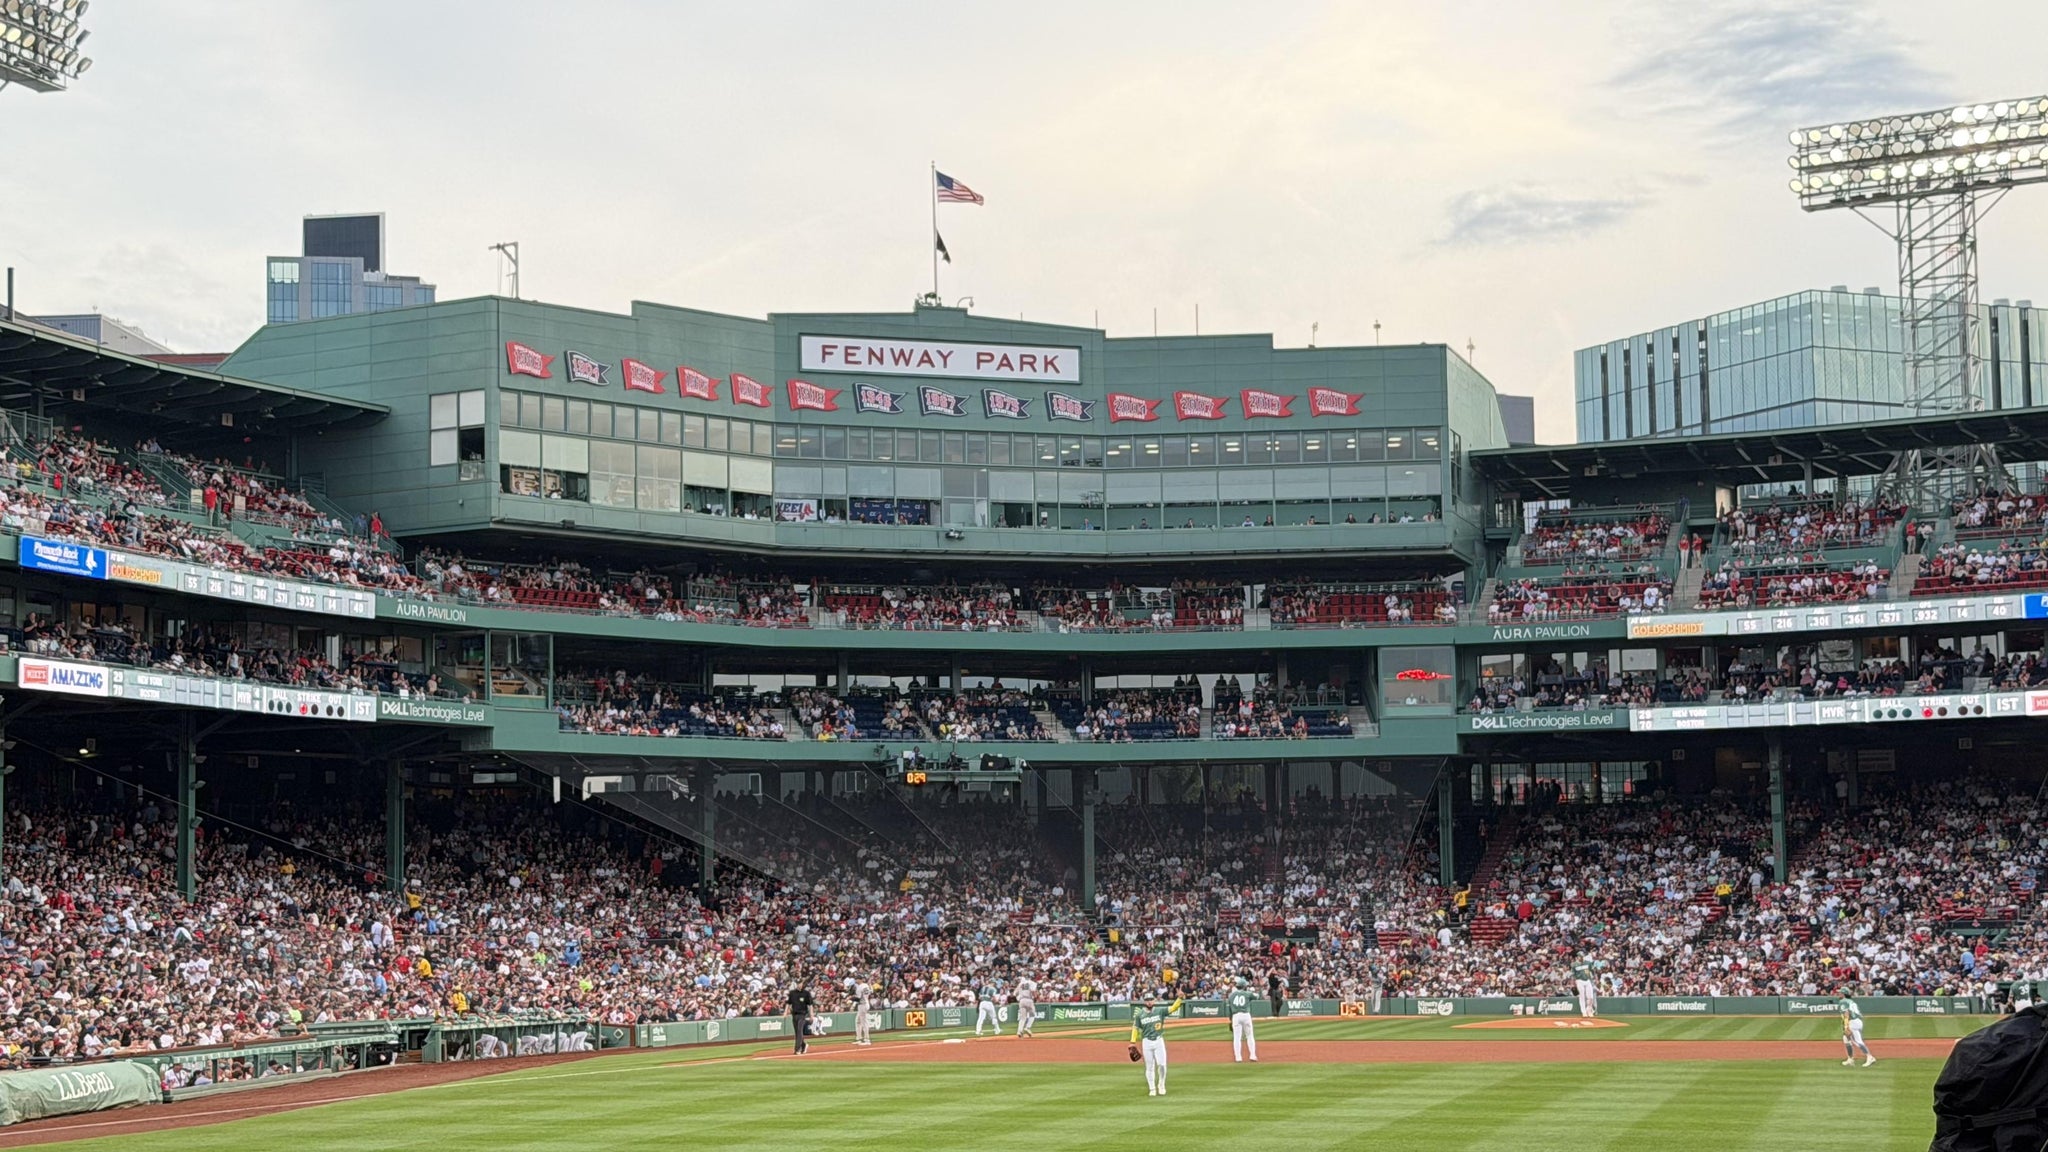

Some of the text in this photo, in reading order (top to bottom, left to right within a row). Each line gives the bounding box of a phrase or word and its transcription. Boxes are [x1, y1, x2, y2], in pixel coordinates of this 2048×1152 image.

[821, 345, 1061, 374] FENWAY PARK
[572, 358, 600, 380] 1904
[989, 395, 1019, 413] 1975
[1113, 399, 1147, 416] 2004
[1180, 398, 1214, 415] 2007
[111, 564, 162, 583] GOLDSCHMIDT
[187, 577, 197, 589] 55
[353, 601, 364, 613] 40
[1957, 607, 1968, 618] 14
[1992, 605, 2006, 616] 40
[427, 606, 466, 622] PAVILION
[1845, 614, 1865, 625] .361
[1880, 612, 1900, 623] .571
[1914, 609, 1938, 621] .932
[1743, 620, 1757, 631] 55
[1776, 618, 1793, 629] 216
[1809, 616, 1829, 627] .301
[1535, 625, 1590, 637] PAVILION
[1632, 622, 1704, 636] GOLDSCHMIDT
[51, 667, 103, 689] AMAZING
[272, 689, 288, 700] BALL
[297, 692, 321, 704] STRIKE
[328, 695, 343, 705] OUT
[1880, 699, 1904, 708] BALL
[1918, 696, 1950, 706] STRIKE
[1960, 696, 1979, 705] OUT
[382, 700, 485, 722] DELL Technologies Level
[1472, 713, 1613, 729] DELL Technologies Level
[1639, 721, 1651, 730] 70
[1676, 720, 1705, 728] BOSTON
[2018, 985, 2030, 996] 39
[1233, 995, 1246, 1007] 40
[1417, 1000, 1438, 1008] Ninety
[1657, 1001, 1707, 1011] smartwater
[1065, 1008, 1102, 1018] National
[1417, 1007, 1438, 1015] Nine
[1808, 1003, 1839, 1013] TICKET
[52, 1070, 115, 1100] L.L.Bean
